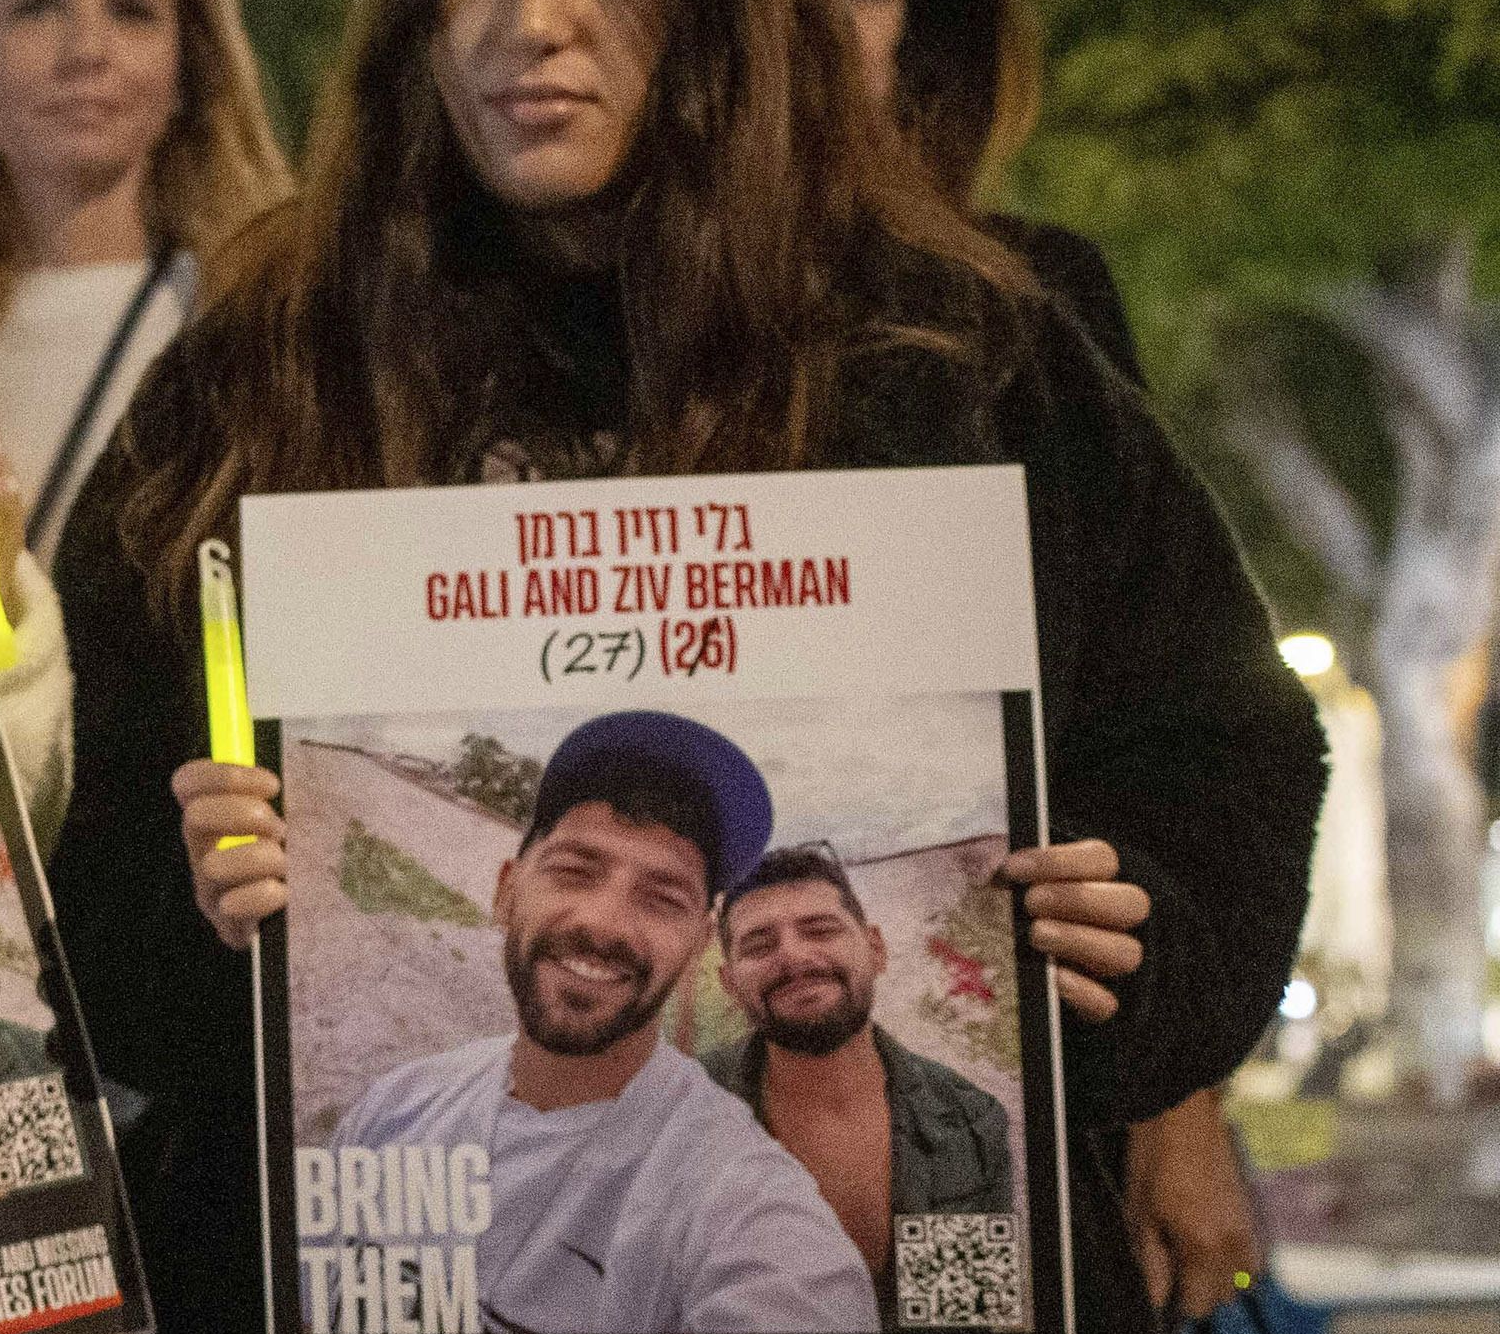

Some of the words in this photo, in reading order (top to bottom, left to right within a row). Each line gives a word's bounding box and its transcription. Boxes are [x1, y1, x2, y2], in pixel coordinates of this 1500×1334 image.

[516, 510, 601, 565] ברמן
[614, 507, 679, 555] וזיו
[693, 503, 752, 551] גלי
[426, 571, 509, 621] GALI
[524, 567, 599, 616] AND
[612, 564, 671, 613] ZIV
[686, 558, 850, 610] BERMAN
[540, 628, 646, 683] (27)
[660, 617, 736, 676] (26)
[299, 1143, 491, 1238] BRING
[30, 1255, 119, 1311] FORUM
